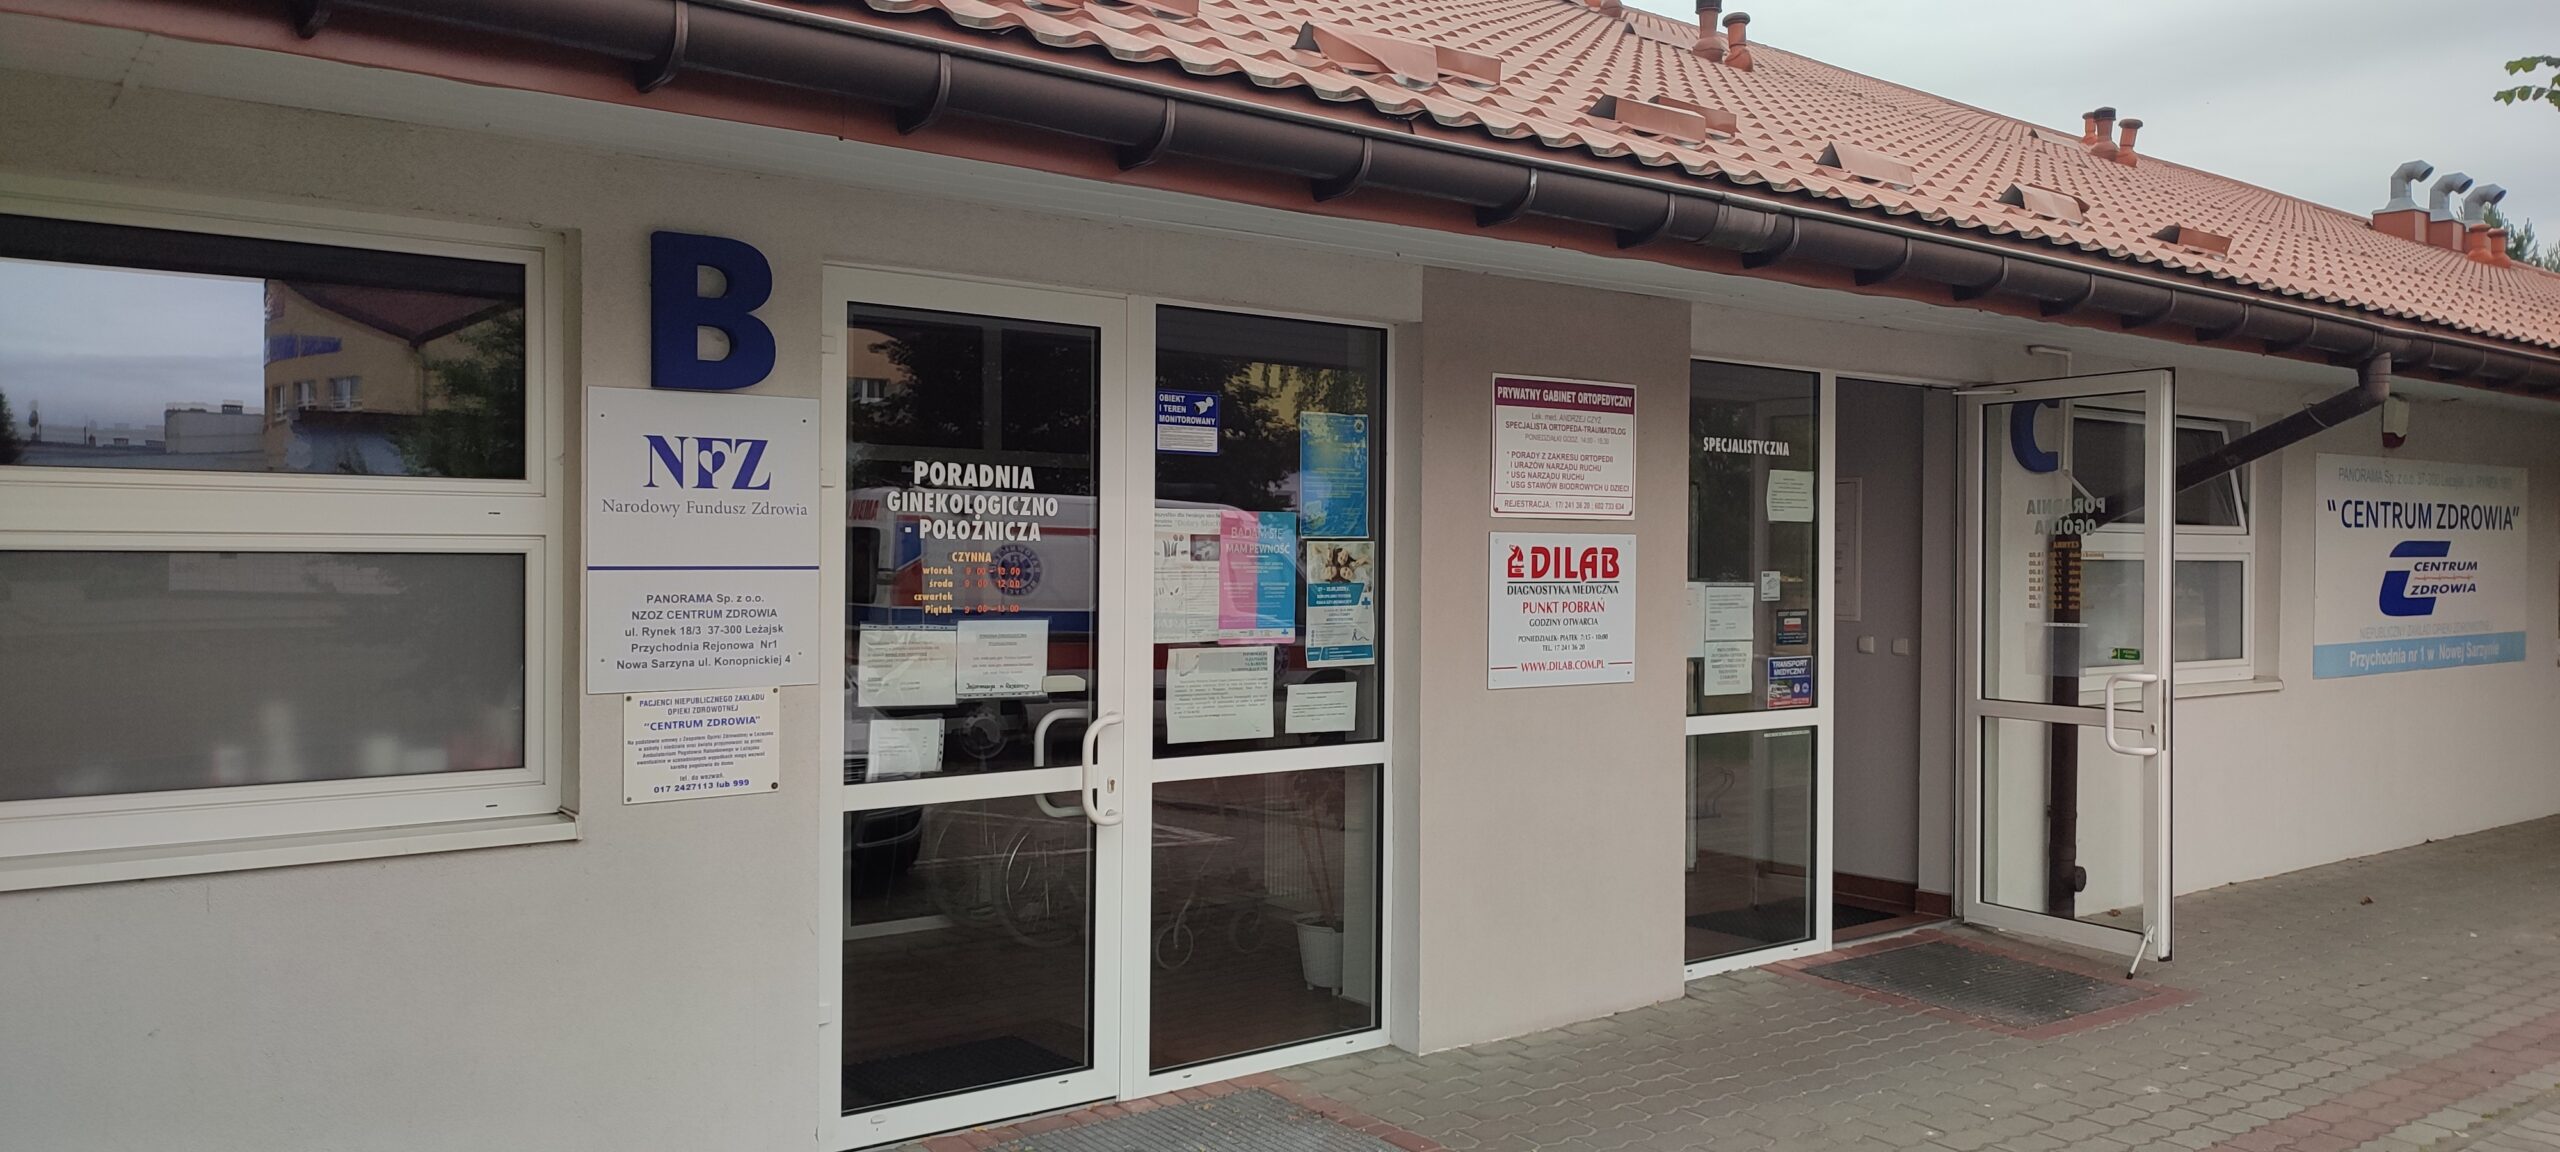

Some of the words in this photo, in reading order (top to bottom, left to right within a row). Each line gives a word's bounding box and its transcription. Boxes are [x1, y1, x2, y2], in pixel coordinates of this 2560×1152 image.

[650, 231, 776, 390] B
[1159, 394, 1185, 402] OBIEKT
[1498, 387, 1541, 401] PRYWATNY
[1543, 390, 1576, 403] GABINET
[1578, 393, 1632, 407] ORTOPEDYCZNY
[1160, 404, 1161, 412] I
[1163, 405, 1186, 413] TEREN
[1160, 415, 1215, 425] MONITOROWANY
[1505, 421, 1547, 430] SPECJALISTA
[1549, 424, 1626, 435] ORTOPEDA-TRAUMATOLOG
[1703, 436, 1789, 456] SPECJALISTYCZNA
[643, 434, 771, 490] NFZ
[1511, 451, 1540, 460] PORADY
[1548, 453, 1578, 461] ZAKRESU
[1580, 455, 1613, 463] ORTOPEDII
[1514, 461, 1544, 469] URAZÓW
[1580, 464, 1601, 472] RUCHU
[914, 461, 1034, 490] PORADNIA
[1562, 473, 1584, 481] RUCHU
[1527, 480, 1557, 489] STAWÓW
[1559, 483, 1602, 491] BIODROWYCH
[601, 499, 680, 518] Narodowy
[686, 501, 746, 515] Fundusz
[751, 501, 808, 516] Zdrowia
[887, 491, 1058, 516] GINEKOLOGICZNO
[920, 514, 1041, 542] POŁOŻNICZA
[1226, 544, 1249, 553] MAM
[1250, 542, 1290, 554] PEWNOŚĆ
[952, 552, 992, 563] CZYNNA
[923, 566, 952, 574] wtorek
[1531, 546, 1619, 582] DILAB
[2414, 561, 2478, 572] CENTRUM
[1507, 585, 1570, 595] DIAGNOSTYKA
[1572, 585, 1618, 595] MEDYCZNA
[2411, 583, 2476, 596] ZDROWIA
[646, 594, 713, 603] PANORAMA
[716, 594, 733, 604] Sp.
[914, 592, 952, 600] czwartek
[925, 605, 952, 615] Piątek
[1523, 601, 1559, 614] PUNKT
[1562, 597, 1605, 613] POBRAŃ
[632, 611, 663, 620] NZOZ
[667, 610, 722, 619] CENTRUM
[726, 609, 777, 618] ZDROWIA
[1529, 619, 1561, 627] GODZINY
[625, 628, 638, 636] ul.
[642, 627, 676, 638] Rynek
[680, 626, 701, 635] 18/3
[708, 625, 741, 634] 37-300
[746, 624, 783, 635] Leżajsk
[631, 642, 699, 654] Przychodnia
[703, 641, 754, 652] Rejonowa
[760, 640, 777, 649] Nr1
[616, 660, 648, 669] Nowa
[651, 658, 695, 670] Sarzyna
[698, 658, 711, 666] ul.
[714, 656, 781, 667] Konopnickiej
[785, 655, 791, 663] 4
[2350, 651, 2406, 670] Przychodnia
[2408, 651, 2417, 662] nr
[2420, 646, 2424, 660] 1
[2427, 651, 2434, 661] w
[2439, 643, 2465, 662] Nowej
[1521, 660, 1604, 672] WWW.DILAB.COM.PL
[640, 699, 672, 707] PACJENCI
[674, 696, 732, 705] NIEPUBLICZNEGO
[668, 707, 690, 715] OPIEKI
[693, 705, 738, 714] ZDROWOTNEJ
[675, 783, 714, 791] 2427113
